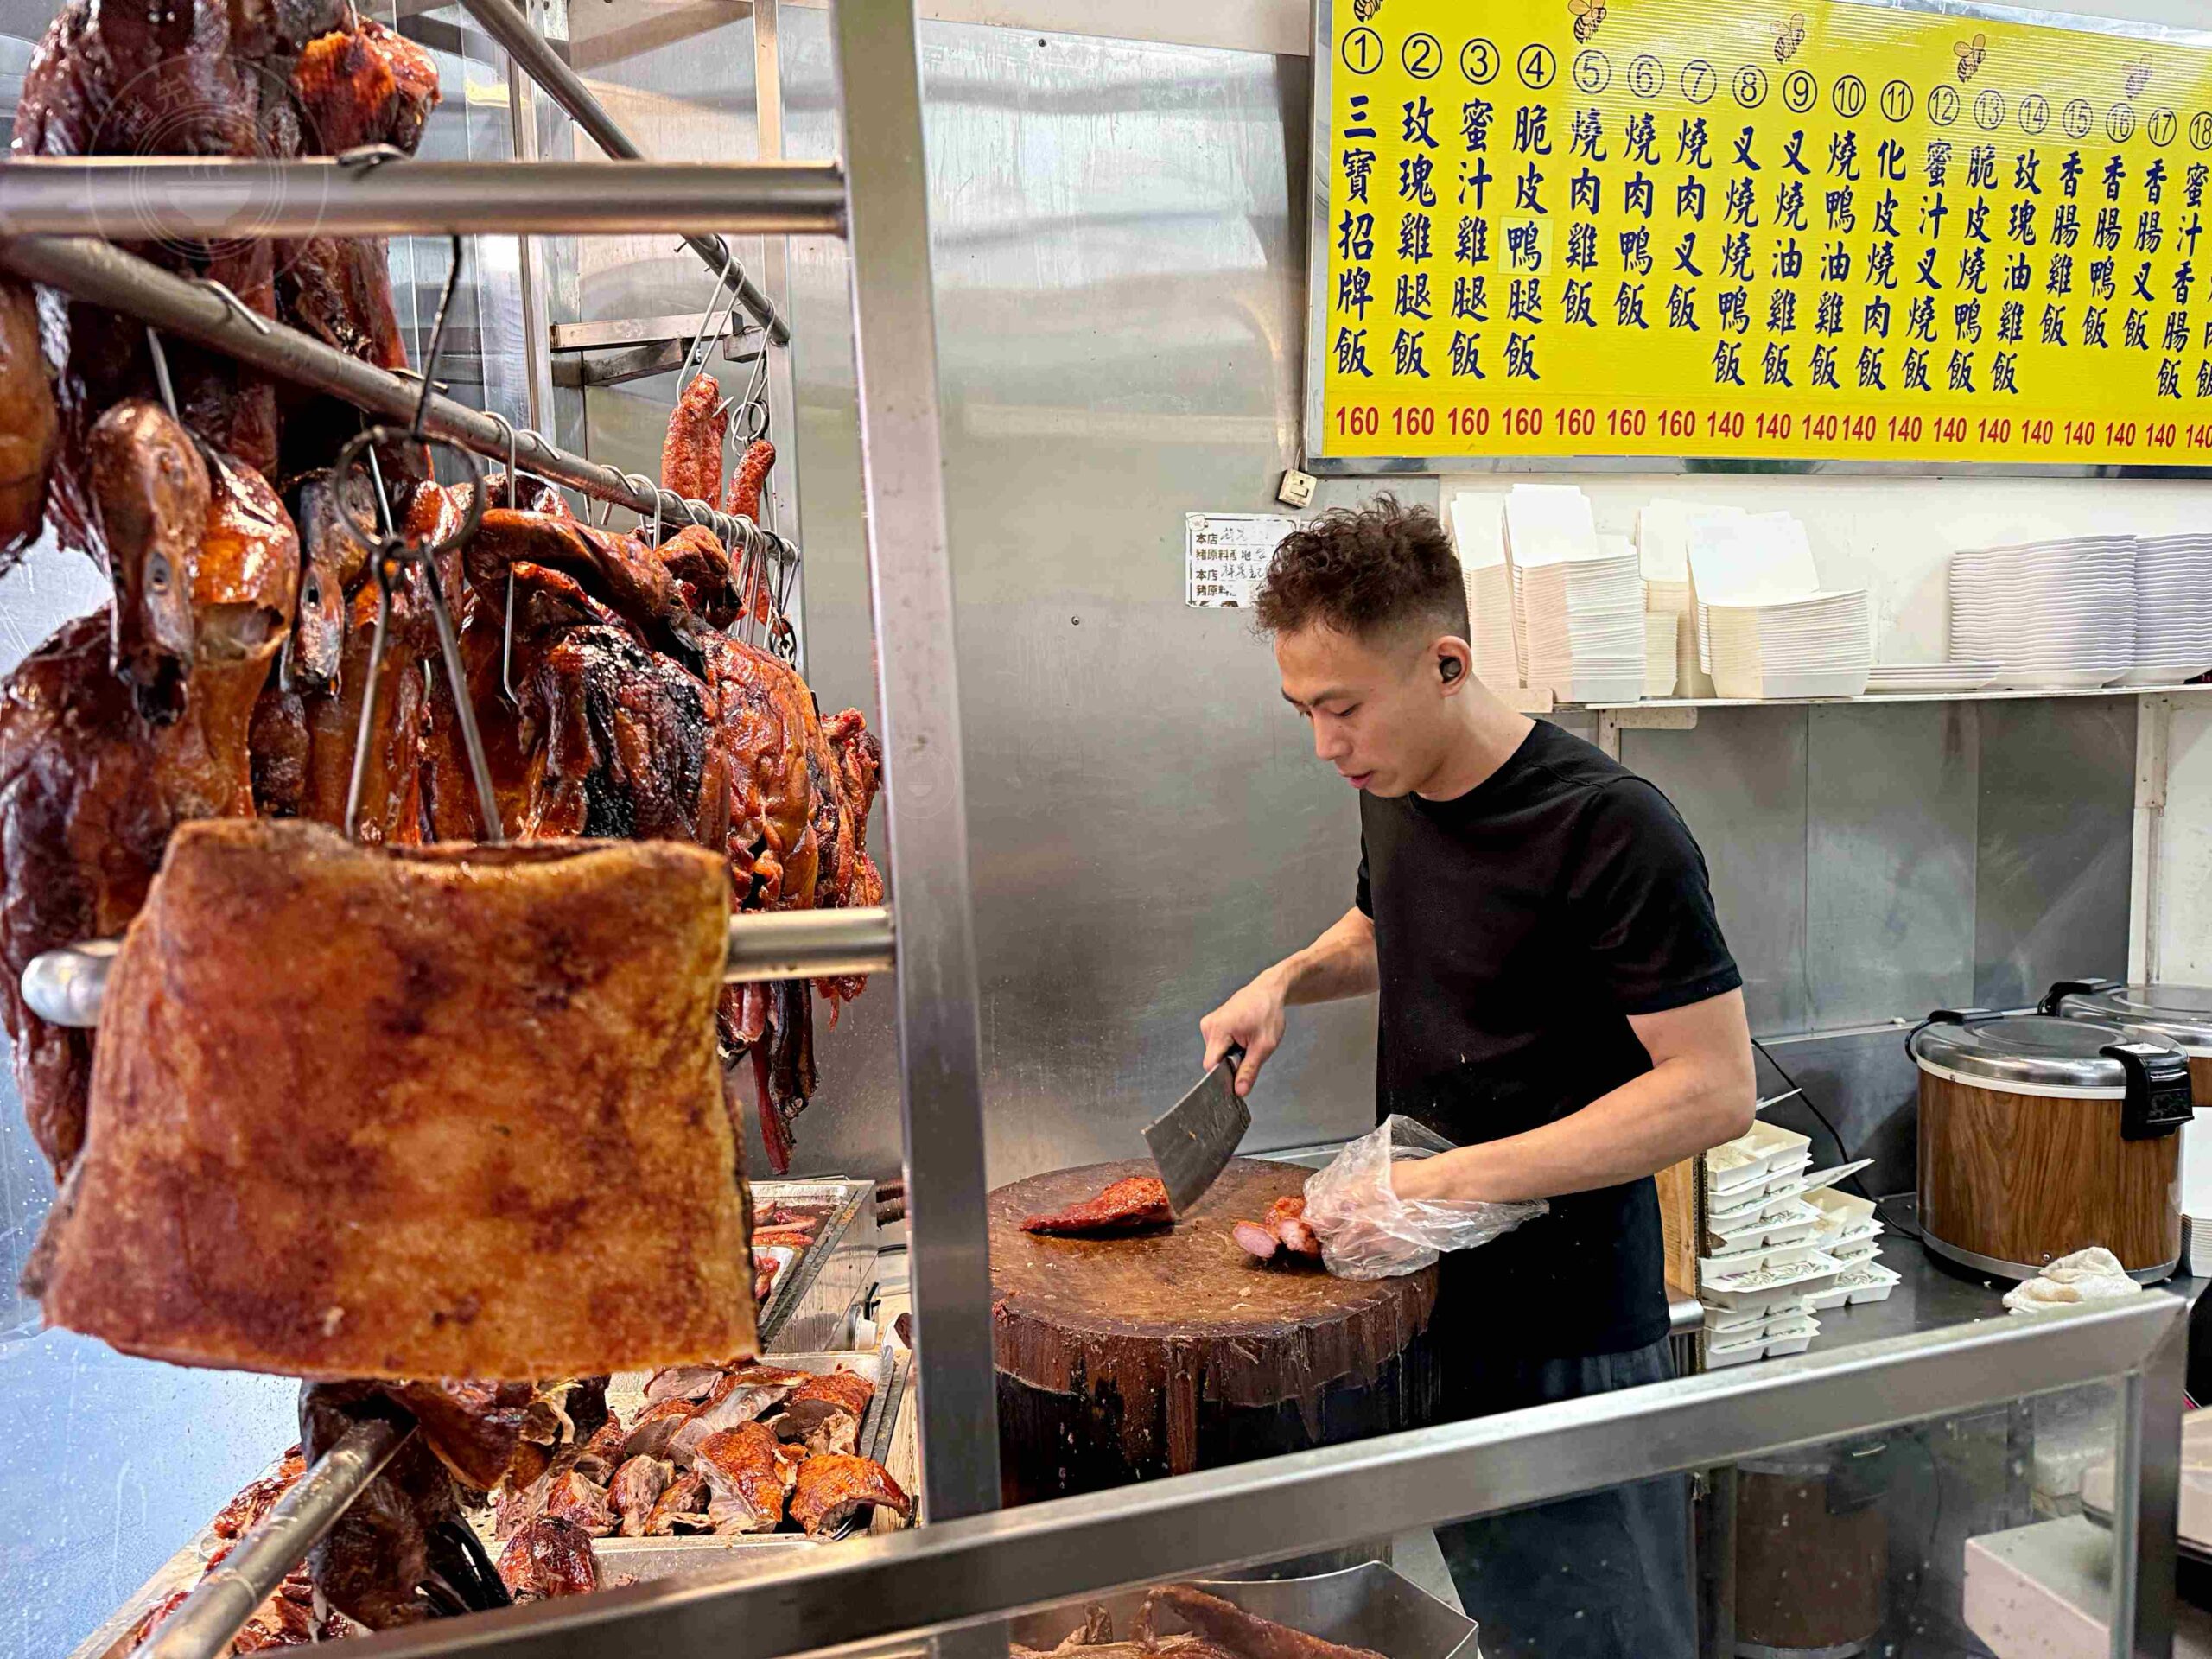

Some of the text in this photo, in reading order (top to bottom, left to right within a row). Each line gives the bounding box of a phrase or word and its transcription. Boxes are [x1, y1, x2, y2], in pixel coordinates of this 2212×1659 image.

[1560, 107, 1607, 327] 燒肉雞飯
[1613, 111, 1661, 330] 燒肉鴨飯
[1665, 117, 1713, 332] 燒肉叉飯
[1332, 95, 1377, 378] 三寶招牌飯
[1391, 95, 1440, 379] 玫瑰雞腿飯
[1447, 97, 1494, 380] 蜜汁雞腿飯
[1503, 104, 1552, 381] 脆皮鴨腿飯
[2039, 150, 2084, 347] 香腸雞飯
[1712, 125, 1762, 386] 叉燒燒鴨飯
[1761, 130, 1811, 388] 叉燒油雞飯
[1808, 130, 1860, 390] 燒鴨油雞飯
[1855, 138, 1906, 391] 化皮燒肉飯
[1902, 137, 1953, 392] 蜜汁叉燒飯
[2082, 154, 2126, 349] 香腸鴨飯
[2123, 158, 2168, 351] 香腸叉飯
[1946, 143, 1999, 394] 脆皮燒鴨飯
[1991, 149, 2042, 395] 玫瑰油雞飯
[2156, 162, 2209, 400] 蜜汁香腸飯
[1336, 406, 1379, 435] 160
[1392, 407, 1434, 435] 160
[1447, 407, 1490, 435] 160
[1503, 407, 1543, 435] 160
[1555, 408, 1595, 435] 160
[1607, 409, 1646, 436] 160
[1658, 410, 1696, 437] 160
[1707, 411, 1745, 439] 140
[1755, 412, 1791, 440] 140
[1802, 414, 1838, 441] 140
[1842, 415, 1877, 442] 140
[1888, 416, 1923, 442] 140
[1934, 417, 1967, 443] 140
[1978, 418, 2011, 444] 140
[2022, 419, 2054, 445] 140
[2064, 421, 2095, 446] 140
[2106, 422, 2136, 447] 140
[2146, 423, 2177, 448] 140
[2185, 424, 2212, 449] 140
